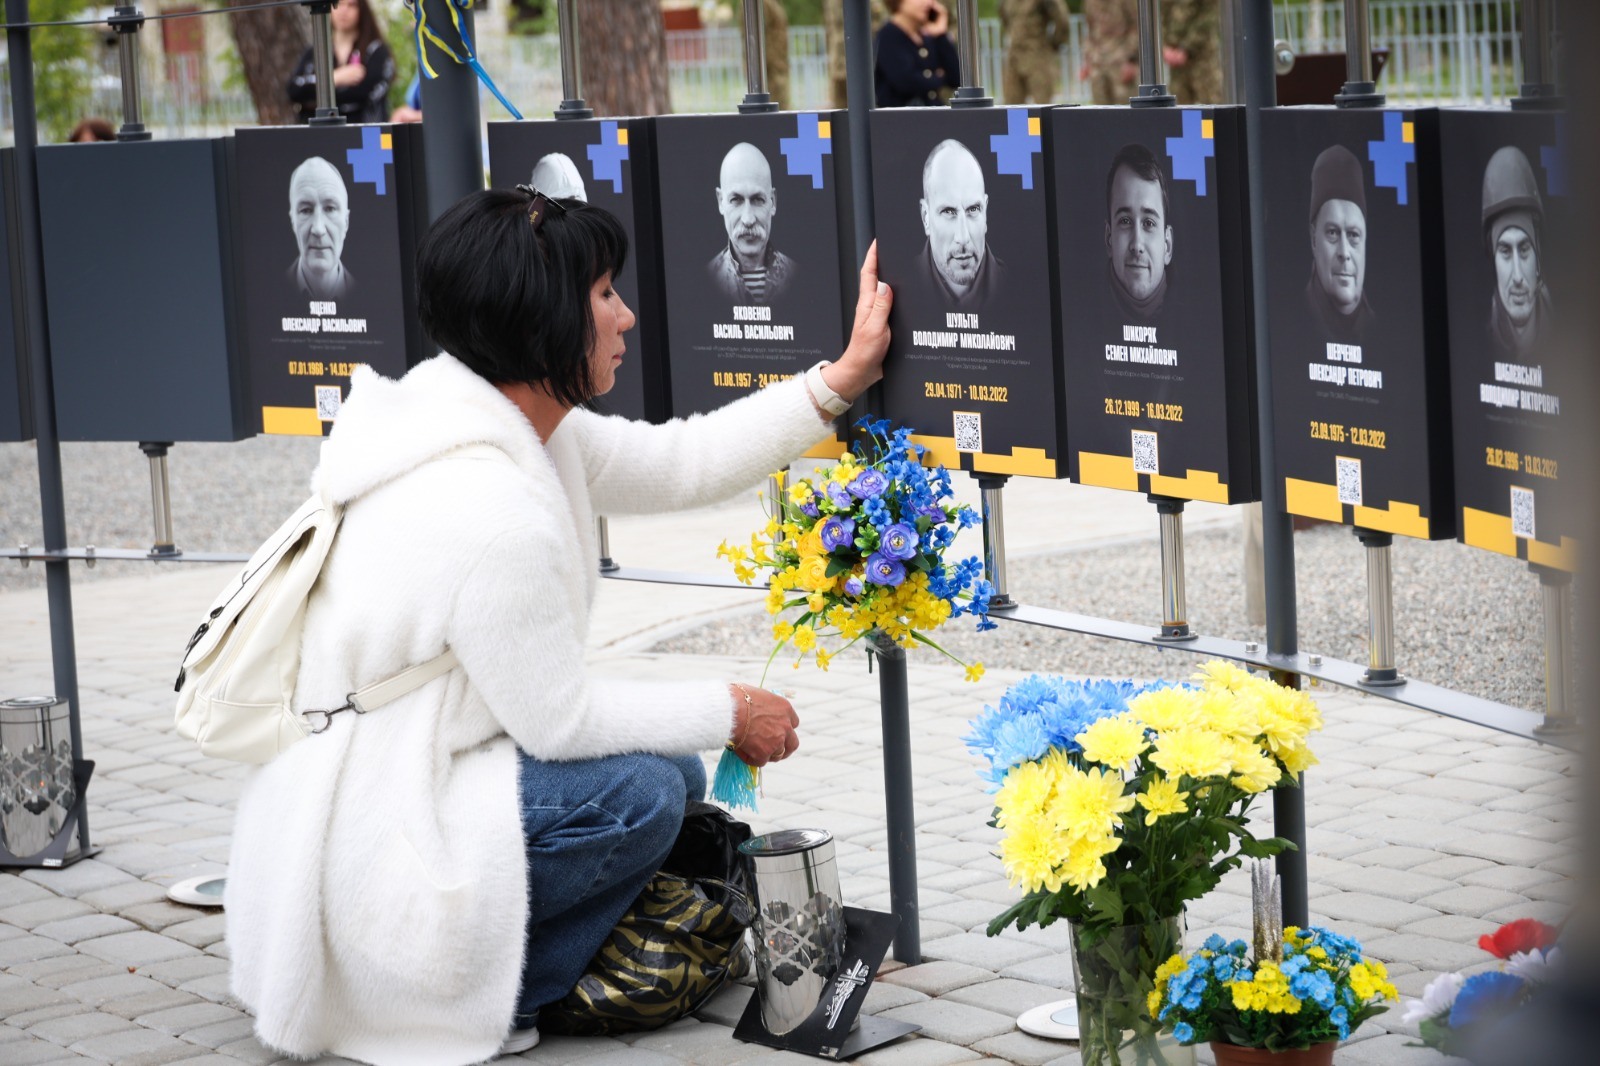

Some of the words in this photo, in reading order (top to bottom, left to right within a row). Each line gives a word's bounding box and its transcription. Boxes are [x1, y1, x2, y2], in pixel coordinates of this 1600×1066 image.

[733, 306, 771, 321] ЯКОВЕНКО
[282, 317, 321, 334] ОЛЕКСАНДР
[321, 318, 367, 333] ВАСИЛЬОВИЧ
[713, 323, 743, 339] ВАСИЛЬ
[744, 325, 794, 341] ВАСИЛЬОВИЧ
[912, 330, 959, 349] ВОЛОДИМИР
[959, 331, 1016, 351] МИКОЛАЙОВИЧ
[1105, 344, 1129, 362] СЕМЕН
[1129, 345, 1178, 367] МИХАЙЛОВИЧ
[713, 372, 752, 387] 01.08.1957
[1309, 362, 1347, 386] ОЛЕКСАНДР
[1347, 367, 1383, 389] ПЕТРОВИЧ
[925, 382, 962, 399] 29.04.1971
[969, 385, 1008, 402] 10.03.2022
[1520, 390, 1560, 415] ВІКТОРОВИЧ
[1104, 398, 1140, 417] 26.12.1999
[1146, 402, 1183, 422] 16.03.2022
[1350, 427, 1386, 449] 12.03.2022
